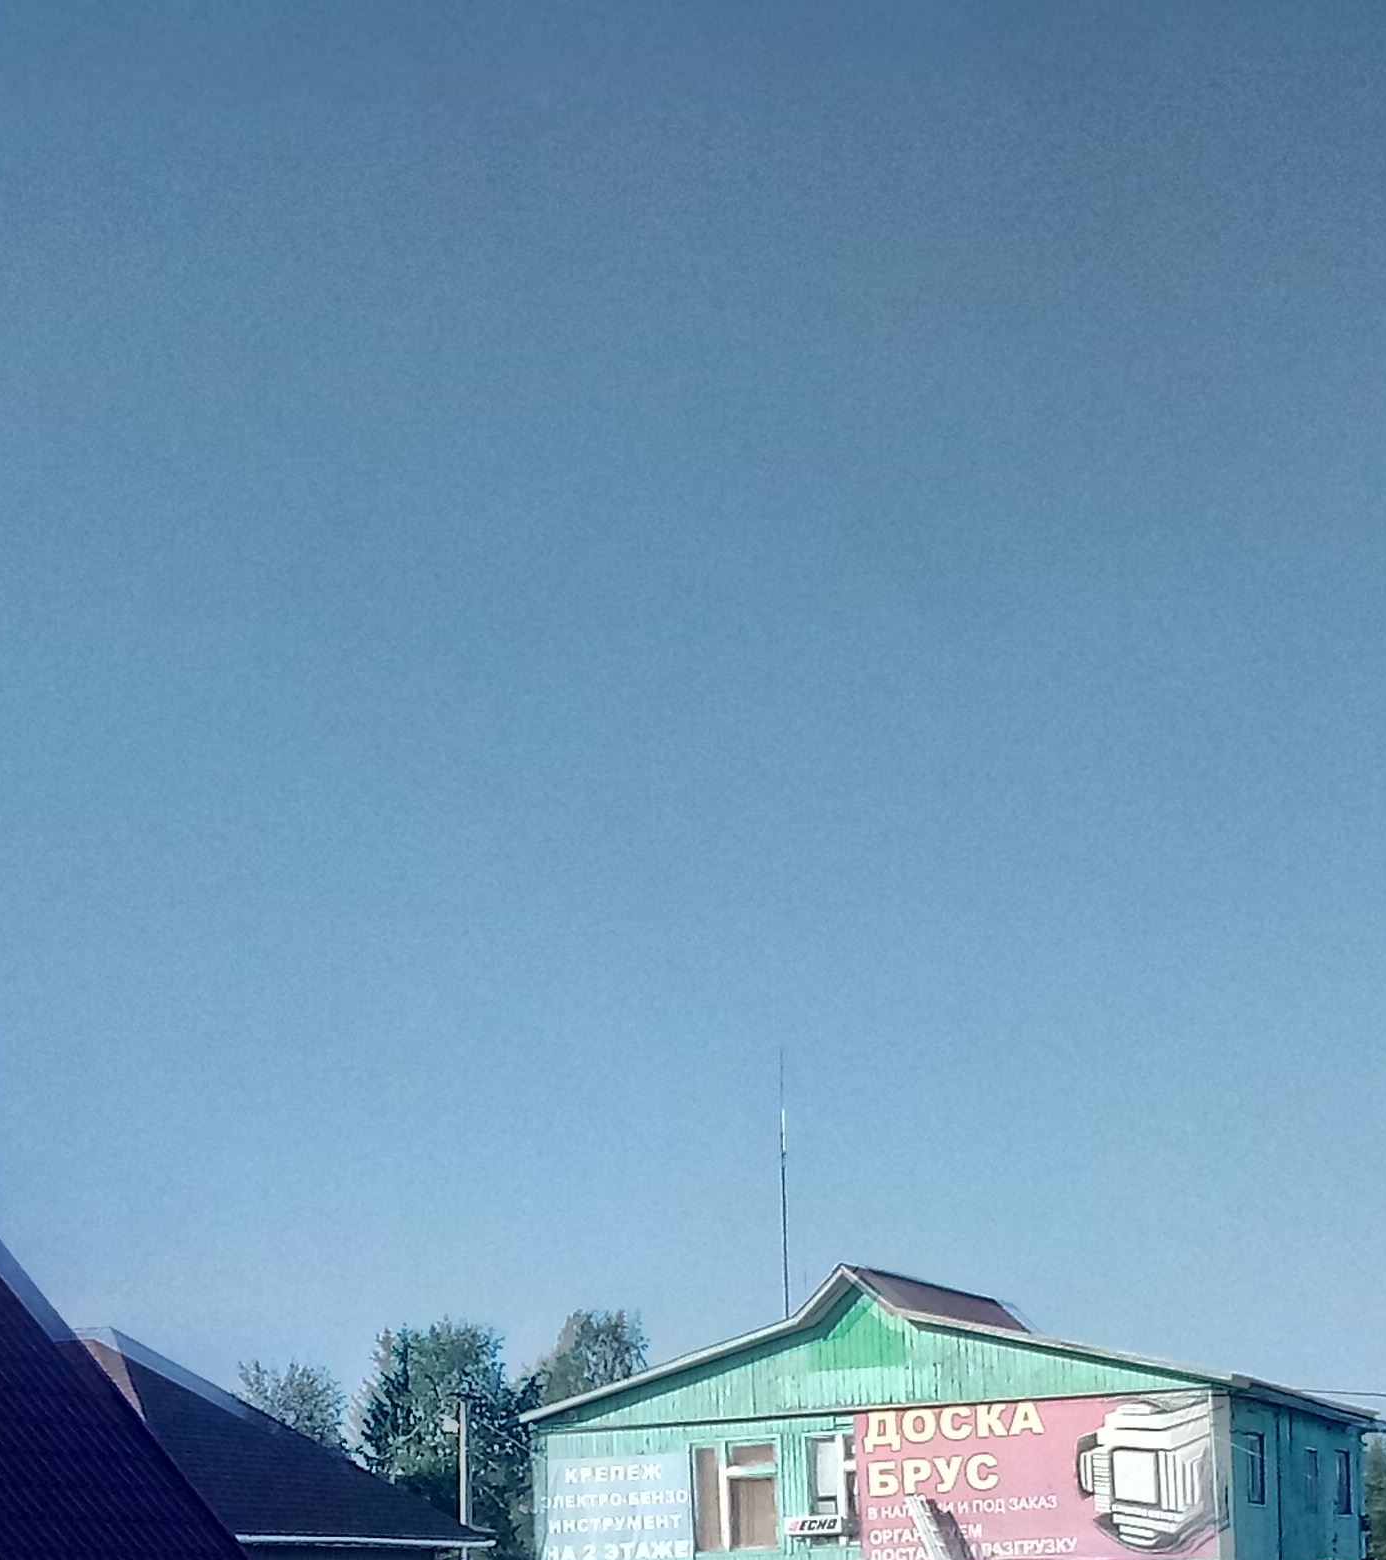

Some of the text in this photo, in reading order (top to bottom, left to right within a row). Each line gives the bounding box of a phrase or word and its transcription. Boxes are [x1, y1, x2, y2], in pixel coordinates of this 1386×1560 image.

[863, 1402, 1045, 1453] ДОСКА
[564, 1464, 662, 1484] КРЕПЕЖ
[867, 1453, 1000, 1498] БРУС
[867, 1506, 878, 1520] В
[957, 1500, 969, 1515] И
[973, 1498, 1007, 1514] ПОД
[1009, 1495, 1058, 1511] ЗАКАЗ
[548, 1513, 683, 1535] ИНСТРУМЕНТ
[869, 1523, 983, 1546] ОРГАНЕМ
